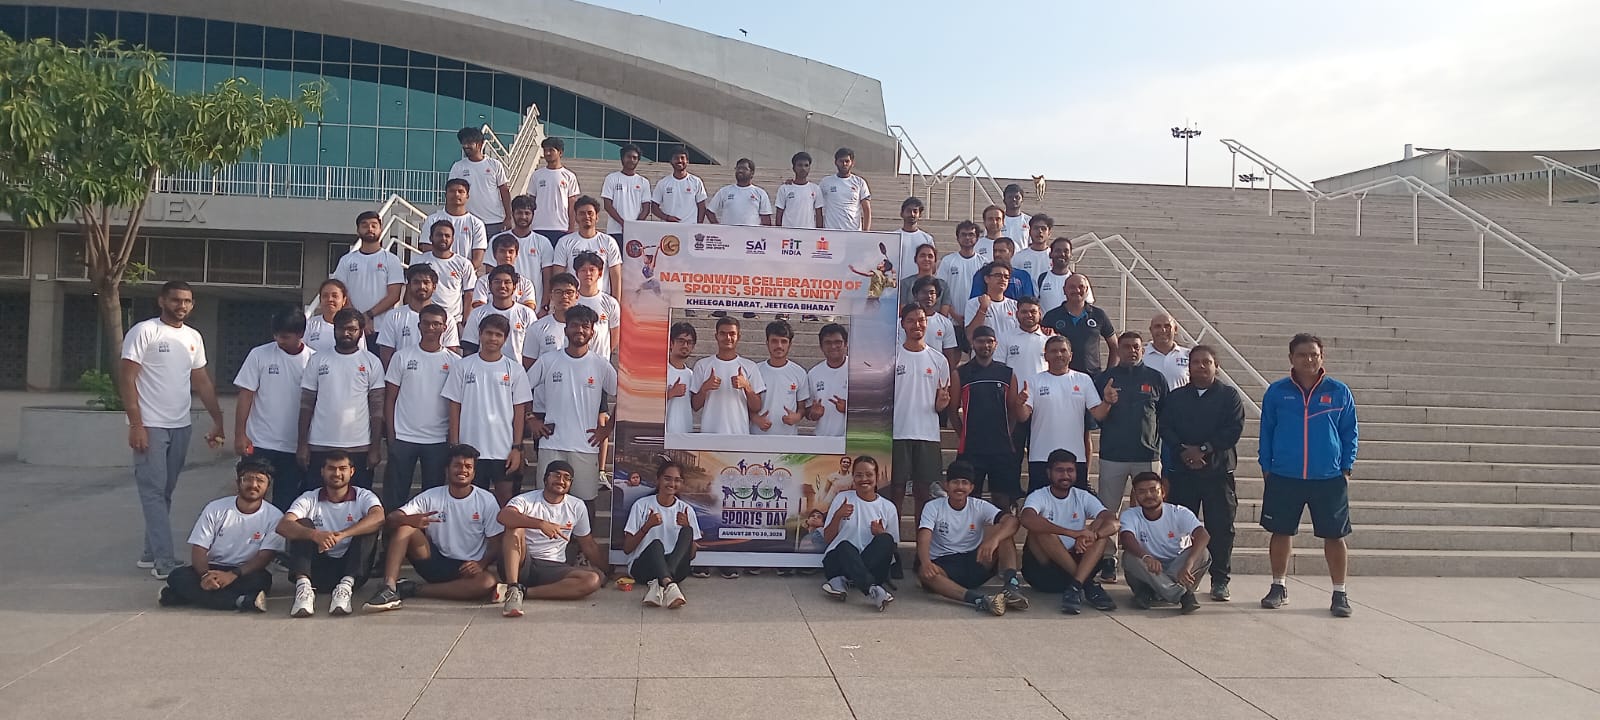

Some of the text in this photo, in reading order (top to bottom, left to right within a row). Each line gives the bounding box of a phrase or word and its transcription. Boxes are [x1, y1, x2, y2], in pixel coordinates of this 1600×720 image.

[659, 271, 862, 290] NATIONWIDE CELEBRATION OF
[684, 283, 841, 299] SPORTS, SPIRIT & UNITY
[686, 298, 835, 312] KHELEGA BHARAT, JEETEGA BHARAT
[721, 511, 788, 526] SPORTS DAY
